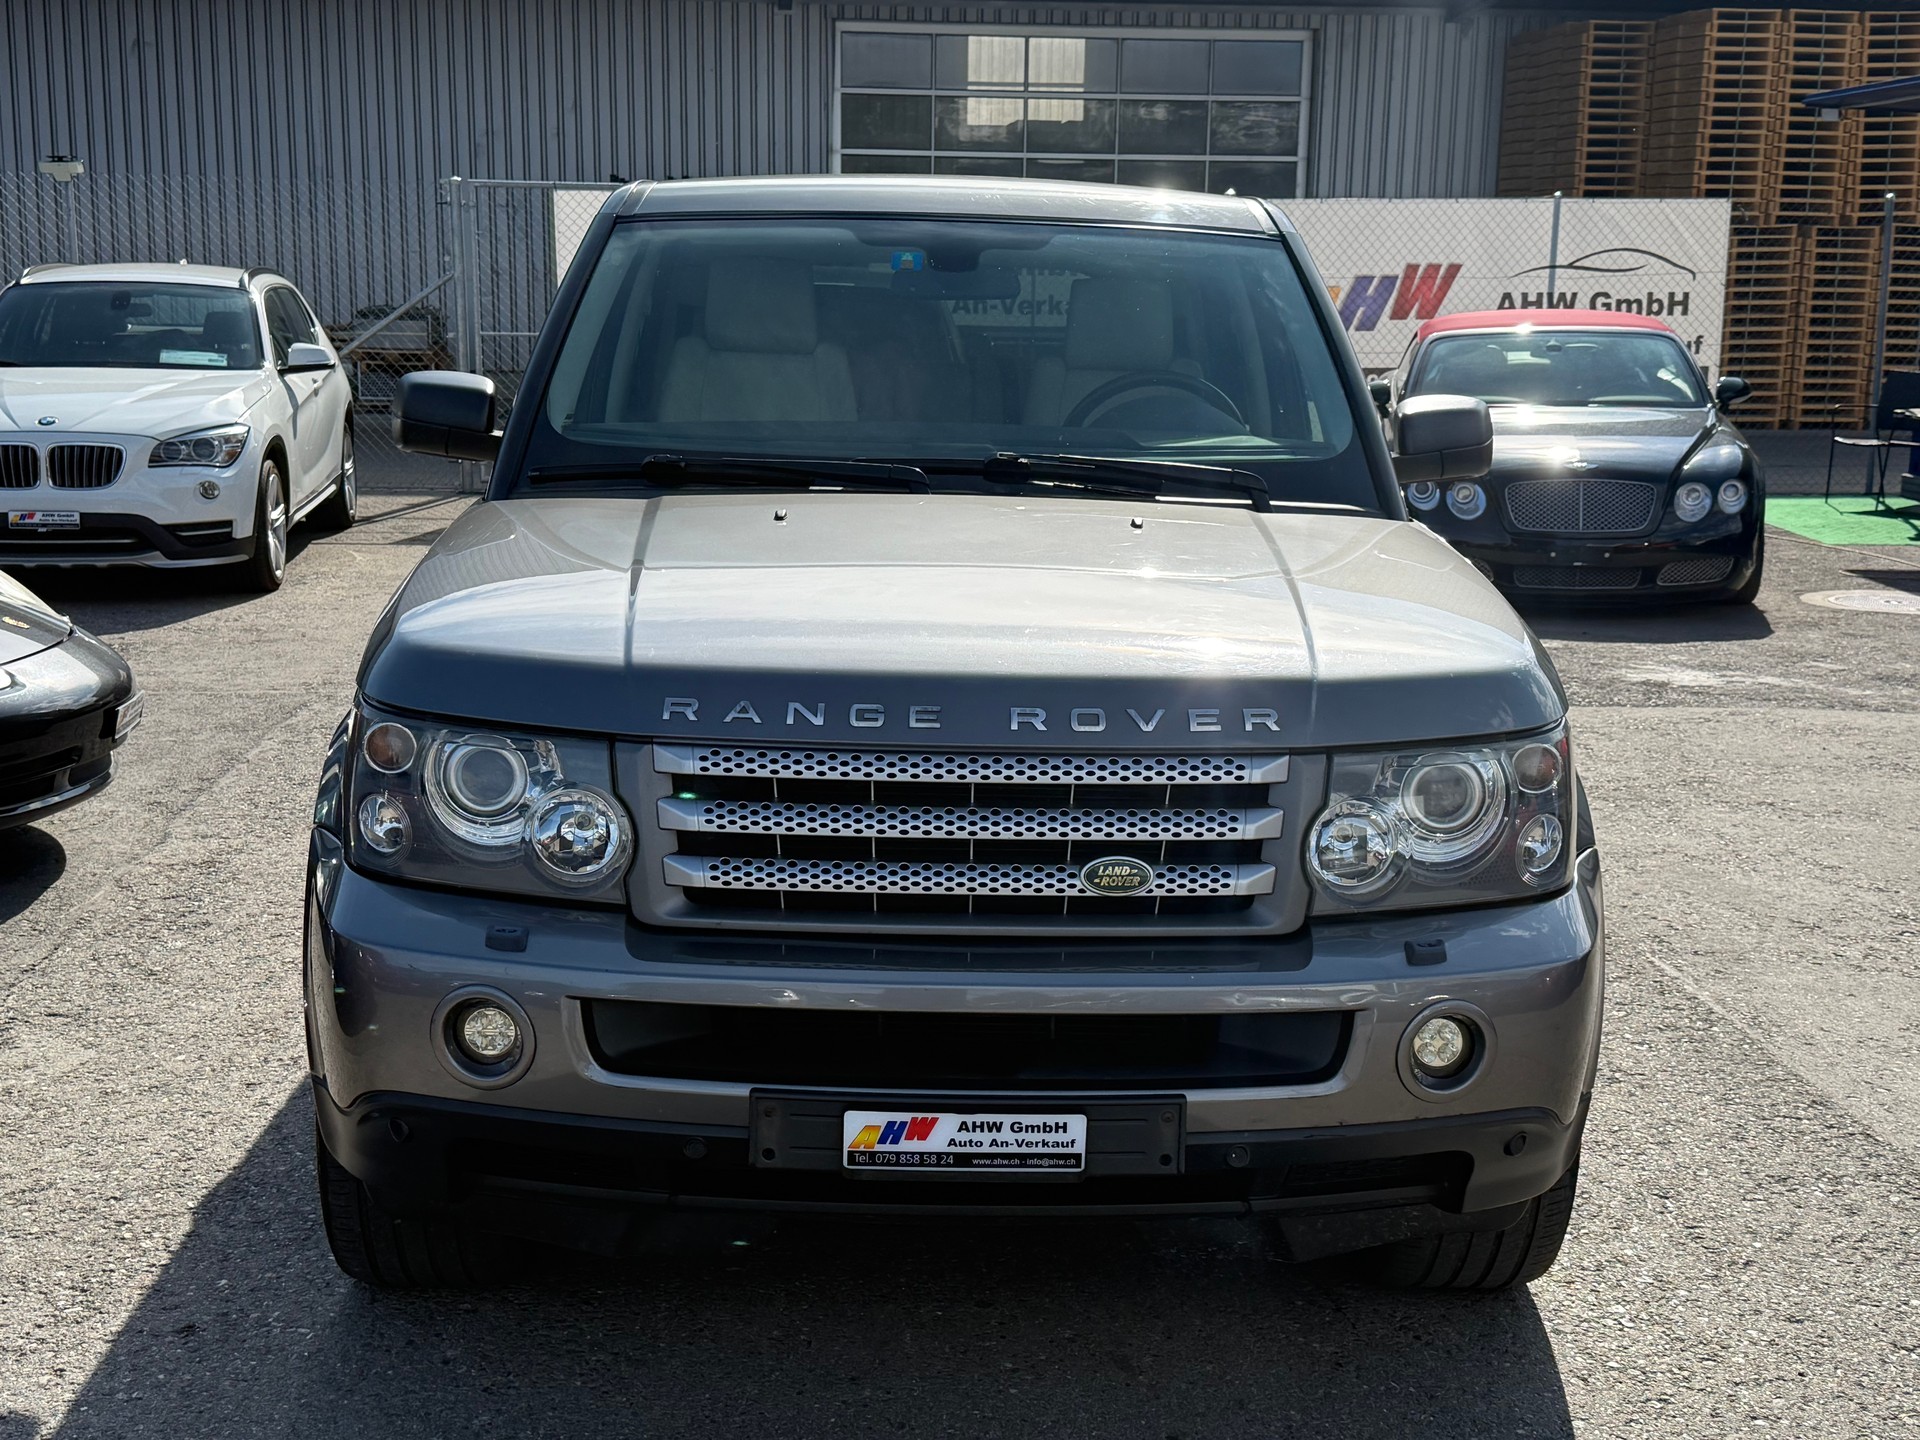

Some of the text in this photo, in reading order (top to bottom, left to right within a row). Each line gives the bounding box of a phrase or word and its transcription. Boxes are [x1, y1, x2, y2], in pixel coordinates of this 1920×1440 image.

[1327, 262, 1463, 332] HW
[951, 294, 1070, 316] An-Verk
[1496, 291, 1690, 317] AHW GmbH
[662, 696, 1281, 732] RANGE ROVER
[1098, 866, 1131, 876] LAND
[1100, 876, 1141, 886] ROVER
[848, 1116, 940, 1149] AHW
[957, 1121, 1068, 1134] AHW GmbH
[946, 1138, 1077, 1149] Auto An-Verkauf
[853, 1153, 954, 1165] Tel. 079 858 58 24
[1026, 1158, 1076, 1166] info@ahw.ch
